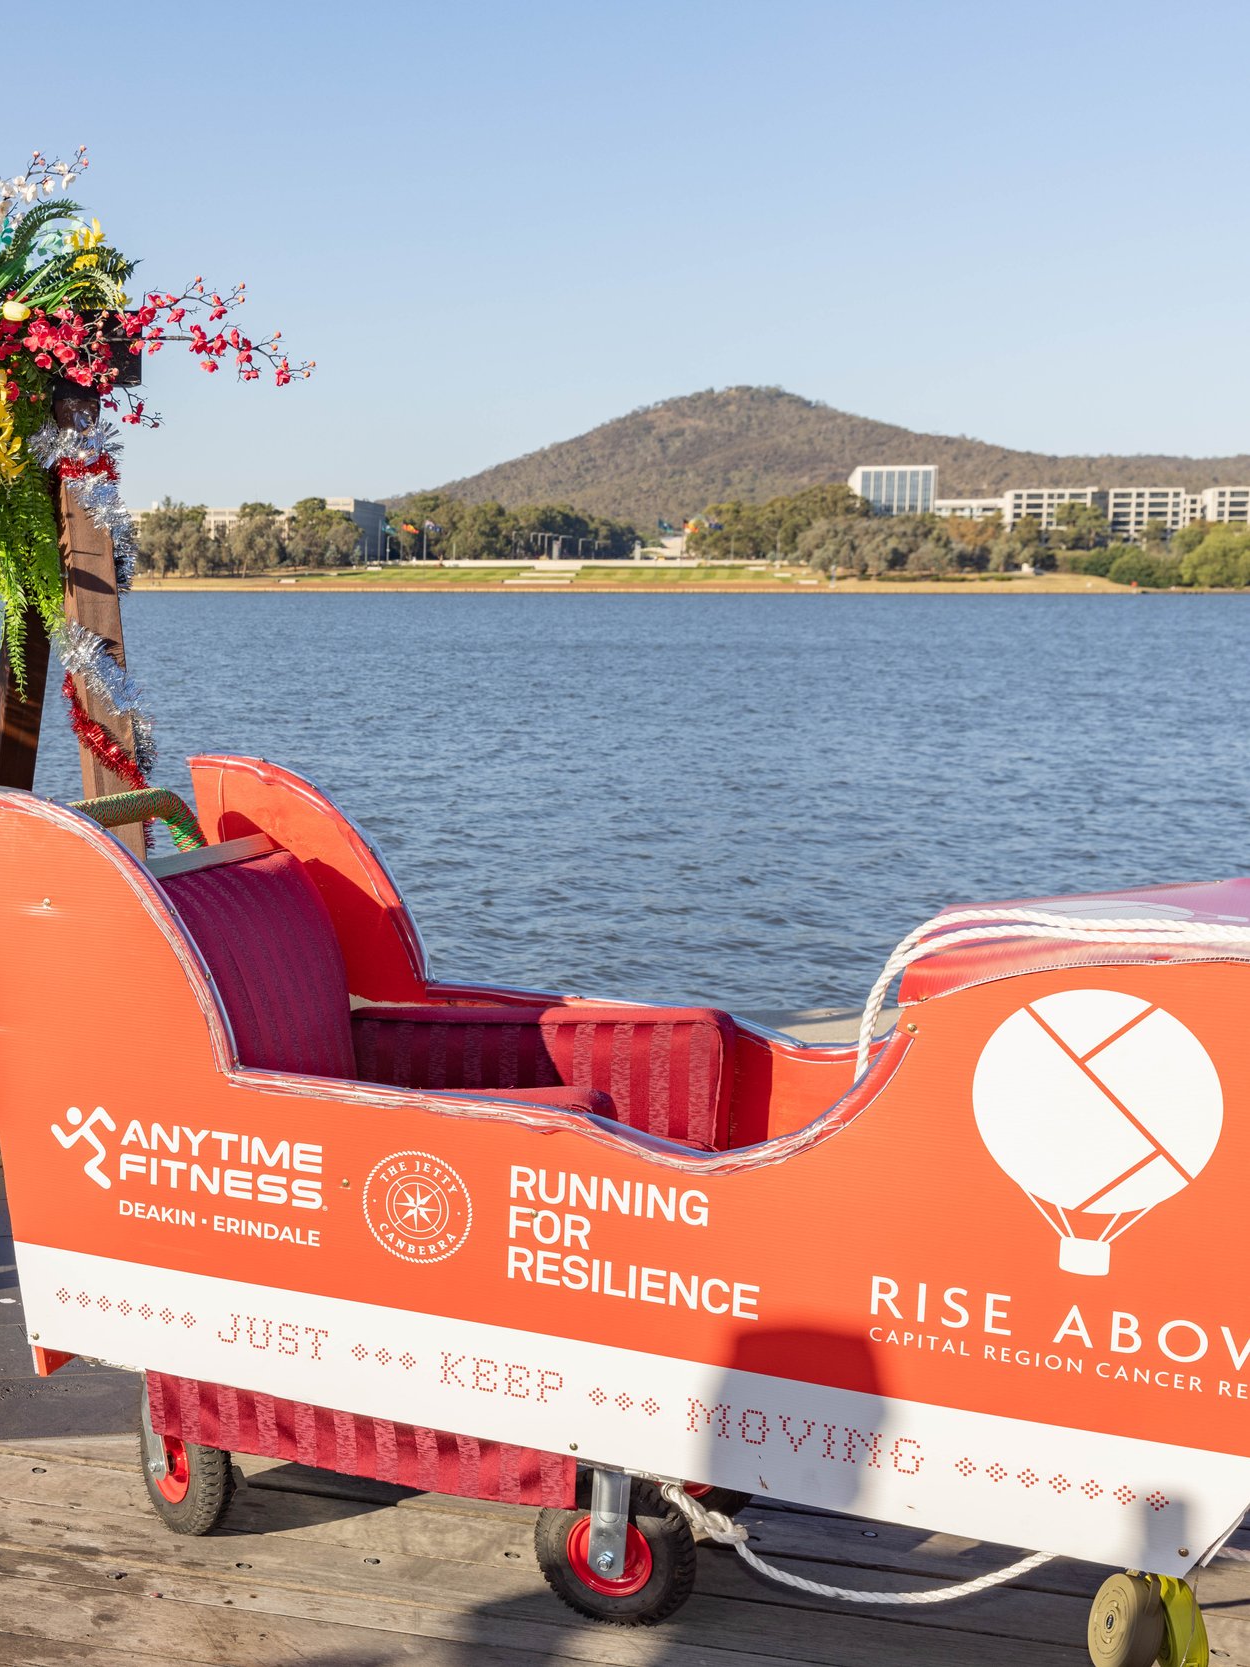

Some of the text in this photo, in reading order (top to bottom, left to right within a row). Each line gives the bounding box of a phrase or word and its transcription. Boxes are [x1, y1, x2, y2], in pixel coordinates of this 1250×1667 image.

[120, 1119, 323, 1174] ANYTIME
[119, 1153, 323, 1210] FITNESS
[379, 1160, 458, 1194] THE JETTY
[510, 1165, 709, 1227] RUNNING
[119, 1199, 321, 1247] DEAKIN ERINDALE
[379, 1223, 457, 1256] CANBERRA
[509, 1205, 591, 1250] FOR
[507, 1246, 760, 1321] RESILIENCE
[870, 1275, 1250, 1372] RISE ABOV
[869, 1327, 1248, 1400] CAPITAL REGION CANCER RE
[218, 1313, 925, 1475] JUST KEEP MOVING
